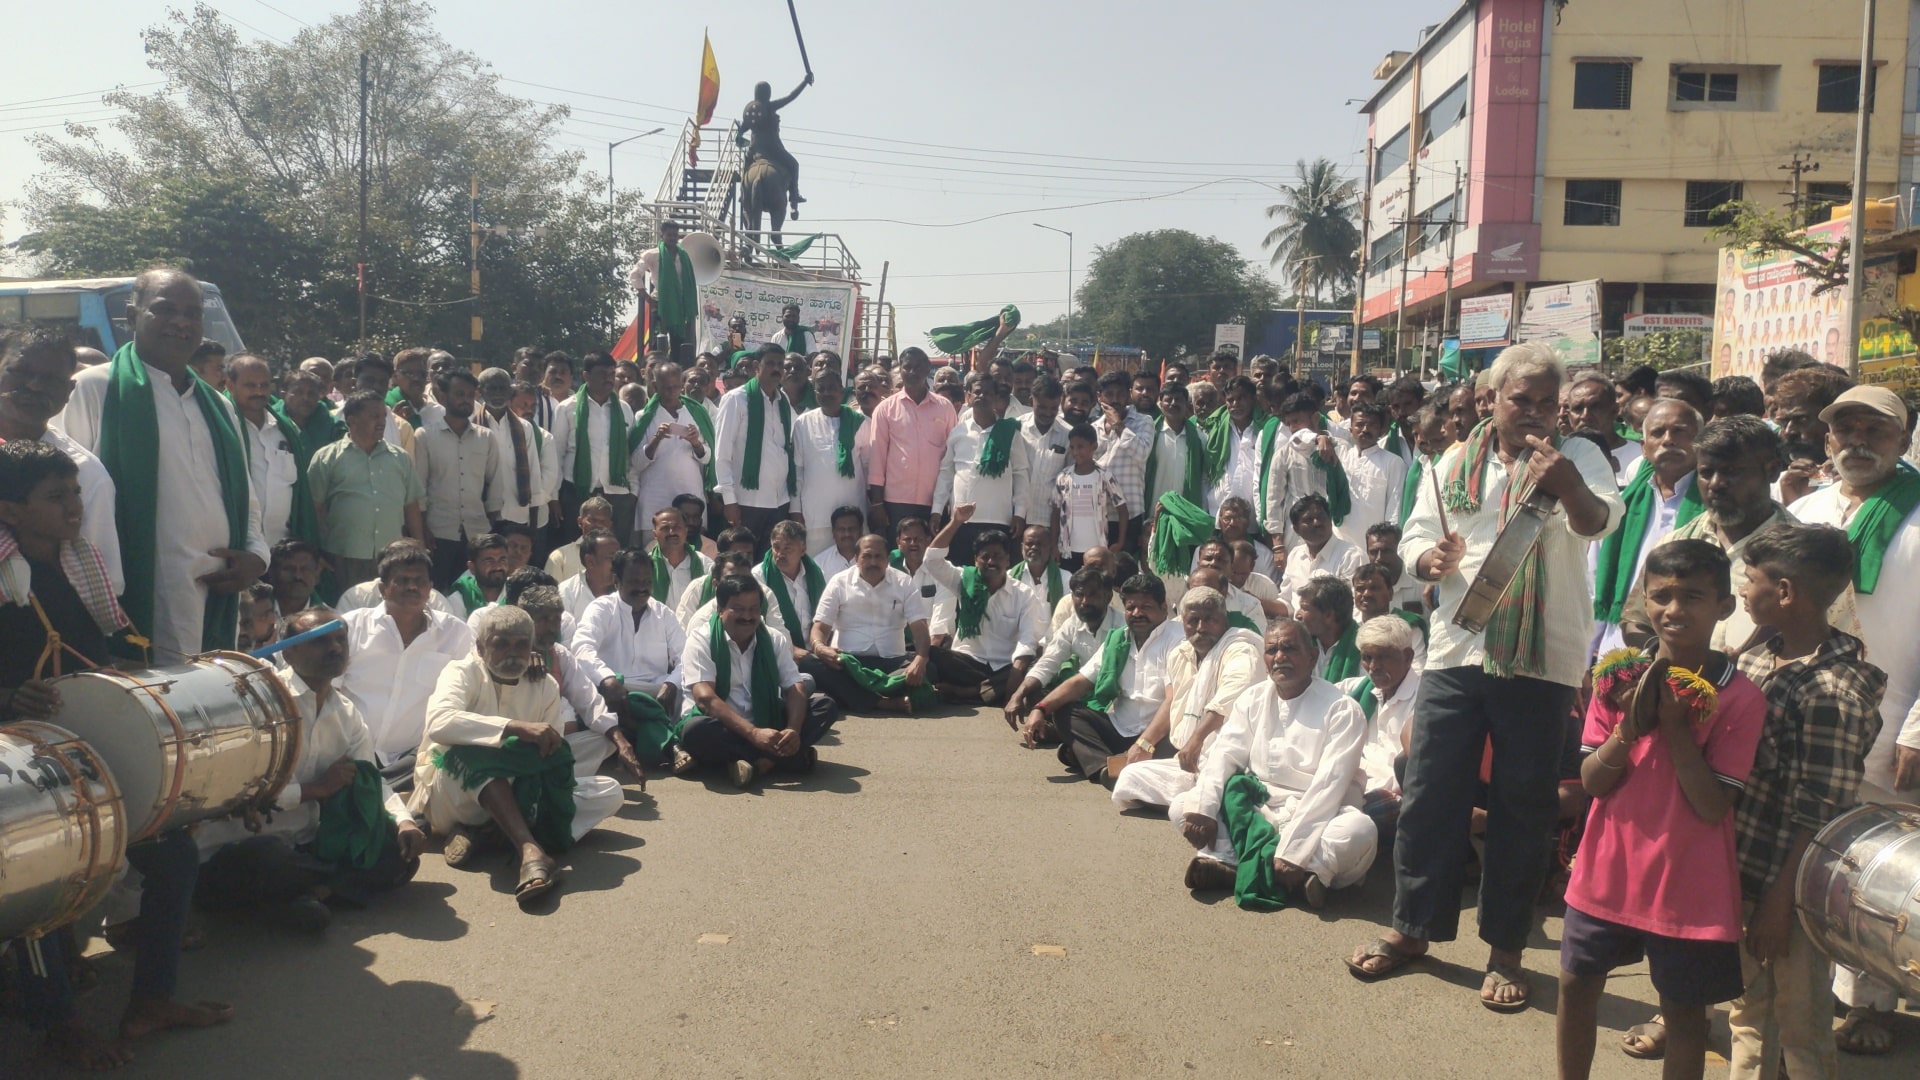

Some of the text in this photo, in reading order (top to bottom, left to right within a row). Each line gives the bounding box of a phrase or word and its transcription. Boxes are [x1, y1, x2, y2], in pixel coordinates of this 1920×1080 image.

[1498, 18, 1537, 33] Hotel
[1500, 36, 1532, 51] Tejas
[1504, 53, 1528, 64] Bar
[734, 287, 753, 304] ರೈತ
[758, 290, 804, 306] ಹೋರಾಟ
[809, 298, 842, 311] ಹಾಗೂ
[1643, 316, 1703, 326] GST BENEFITS
